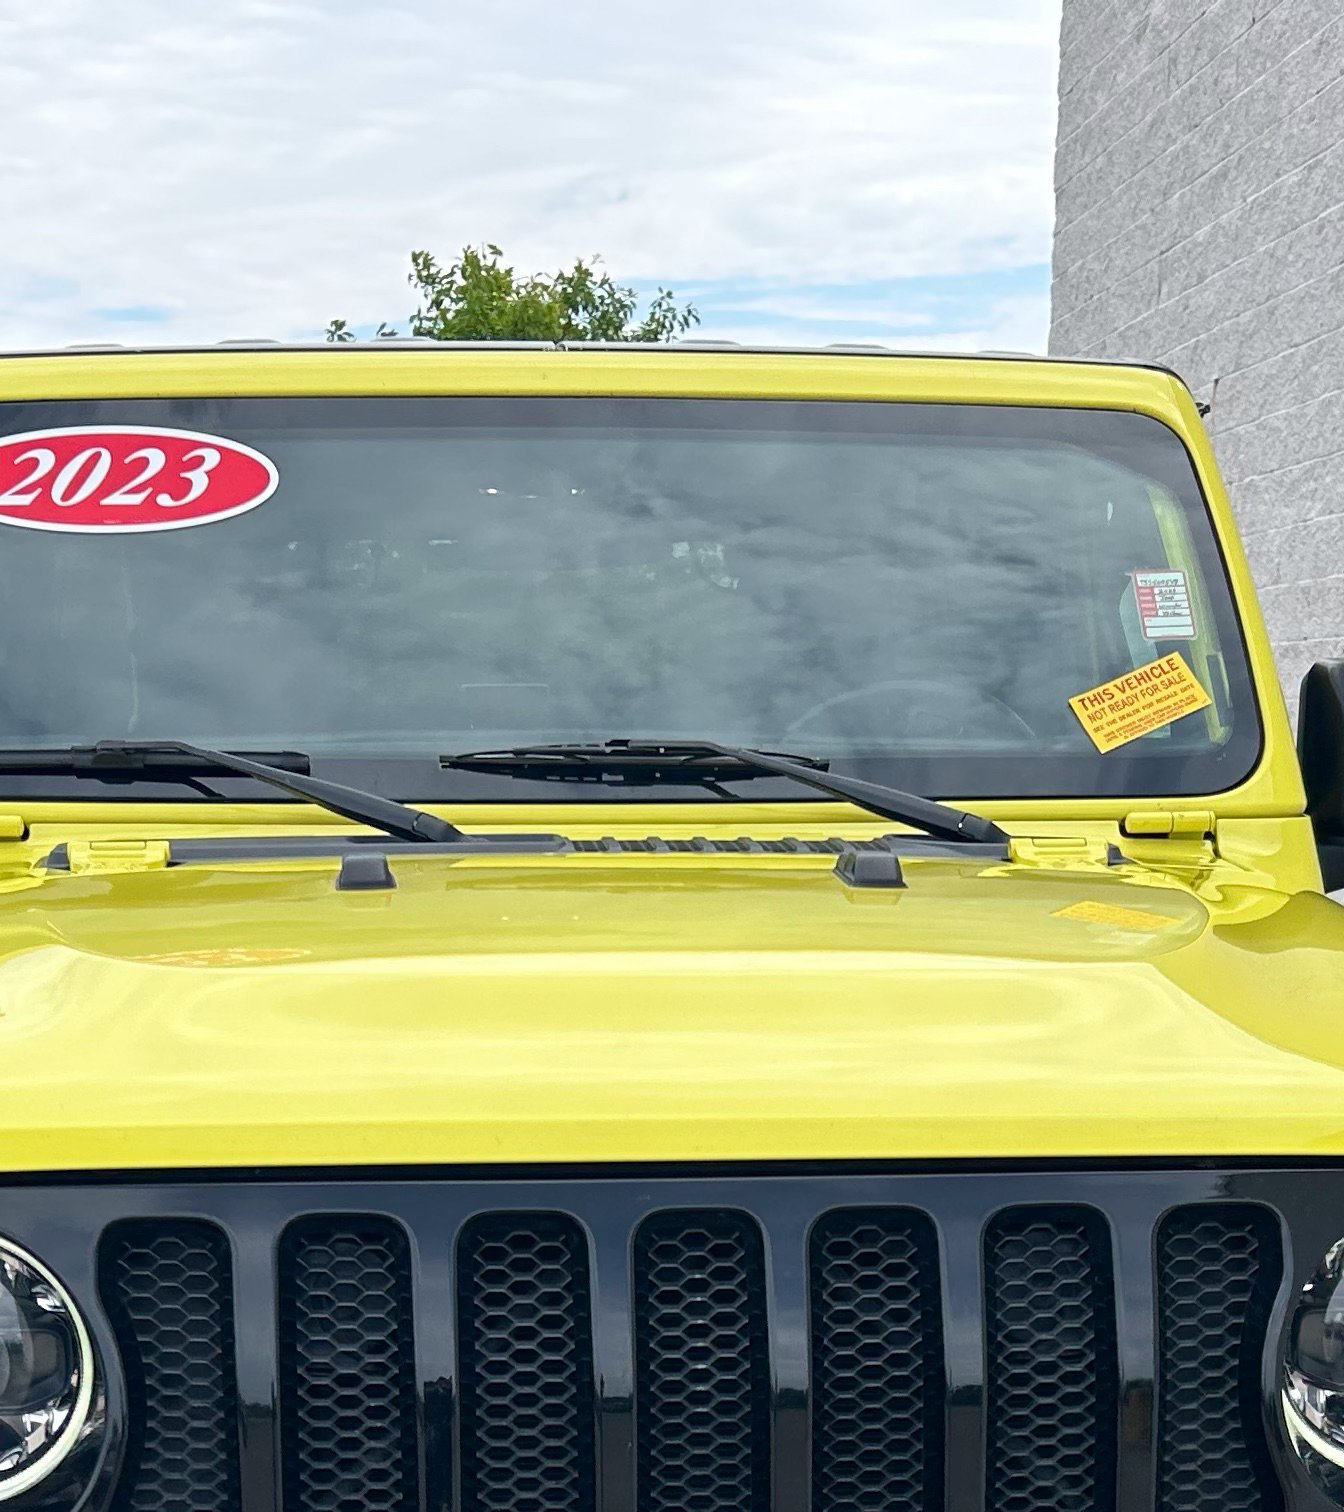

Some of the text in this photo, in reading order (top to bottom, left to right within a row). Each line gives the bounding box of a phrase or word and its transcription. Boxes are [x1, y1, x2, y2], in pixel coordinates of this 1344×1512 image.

[1078, 658, 1179, 711] THIS VEHICLE
[1087, 672, 1186, 724] NOT READY FOR SALE
[1106, 718, 1116, 727] THE
[1118, 708, 1140, 720] DEALER
[1142, 702, 1154, 710] FOR
